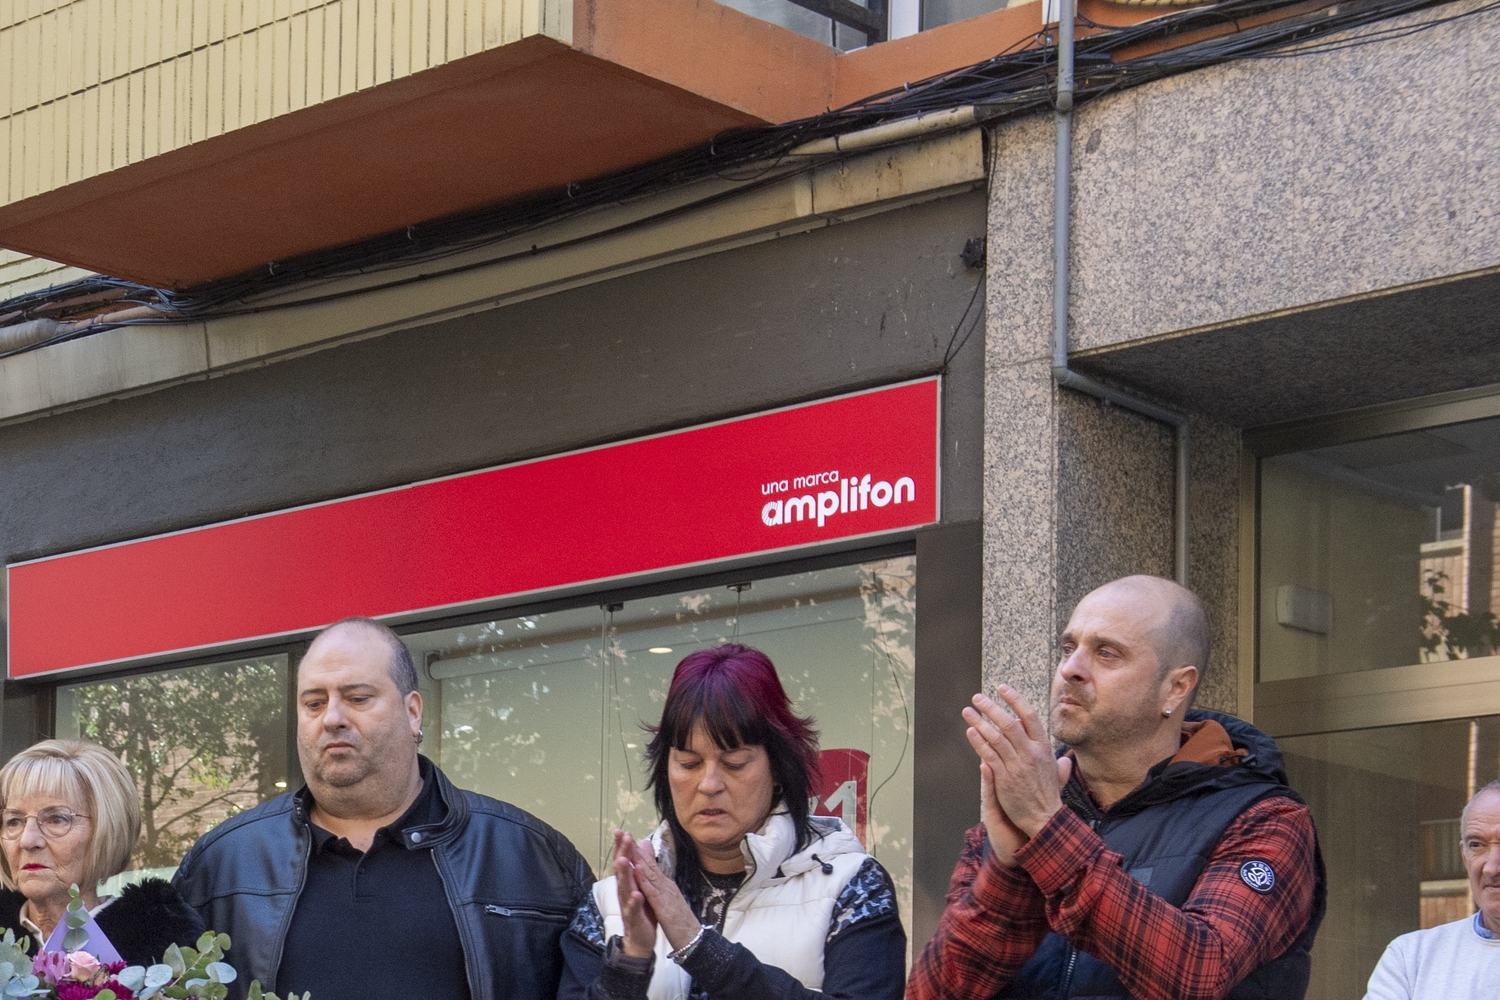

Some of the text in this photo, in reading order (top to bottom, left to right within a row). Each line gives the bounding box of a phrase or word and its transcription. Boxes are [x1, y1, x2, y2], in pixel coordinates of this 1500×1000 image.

[761, 470, 840, 496] una marca
[761, 473, 916, 528] amplifon
